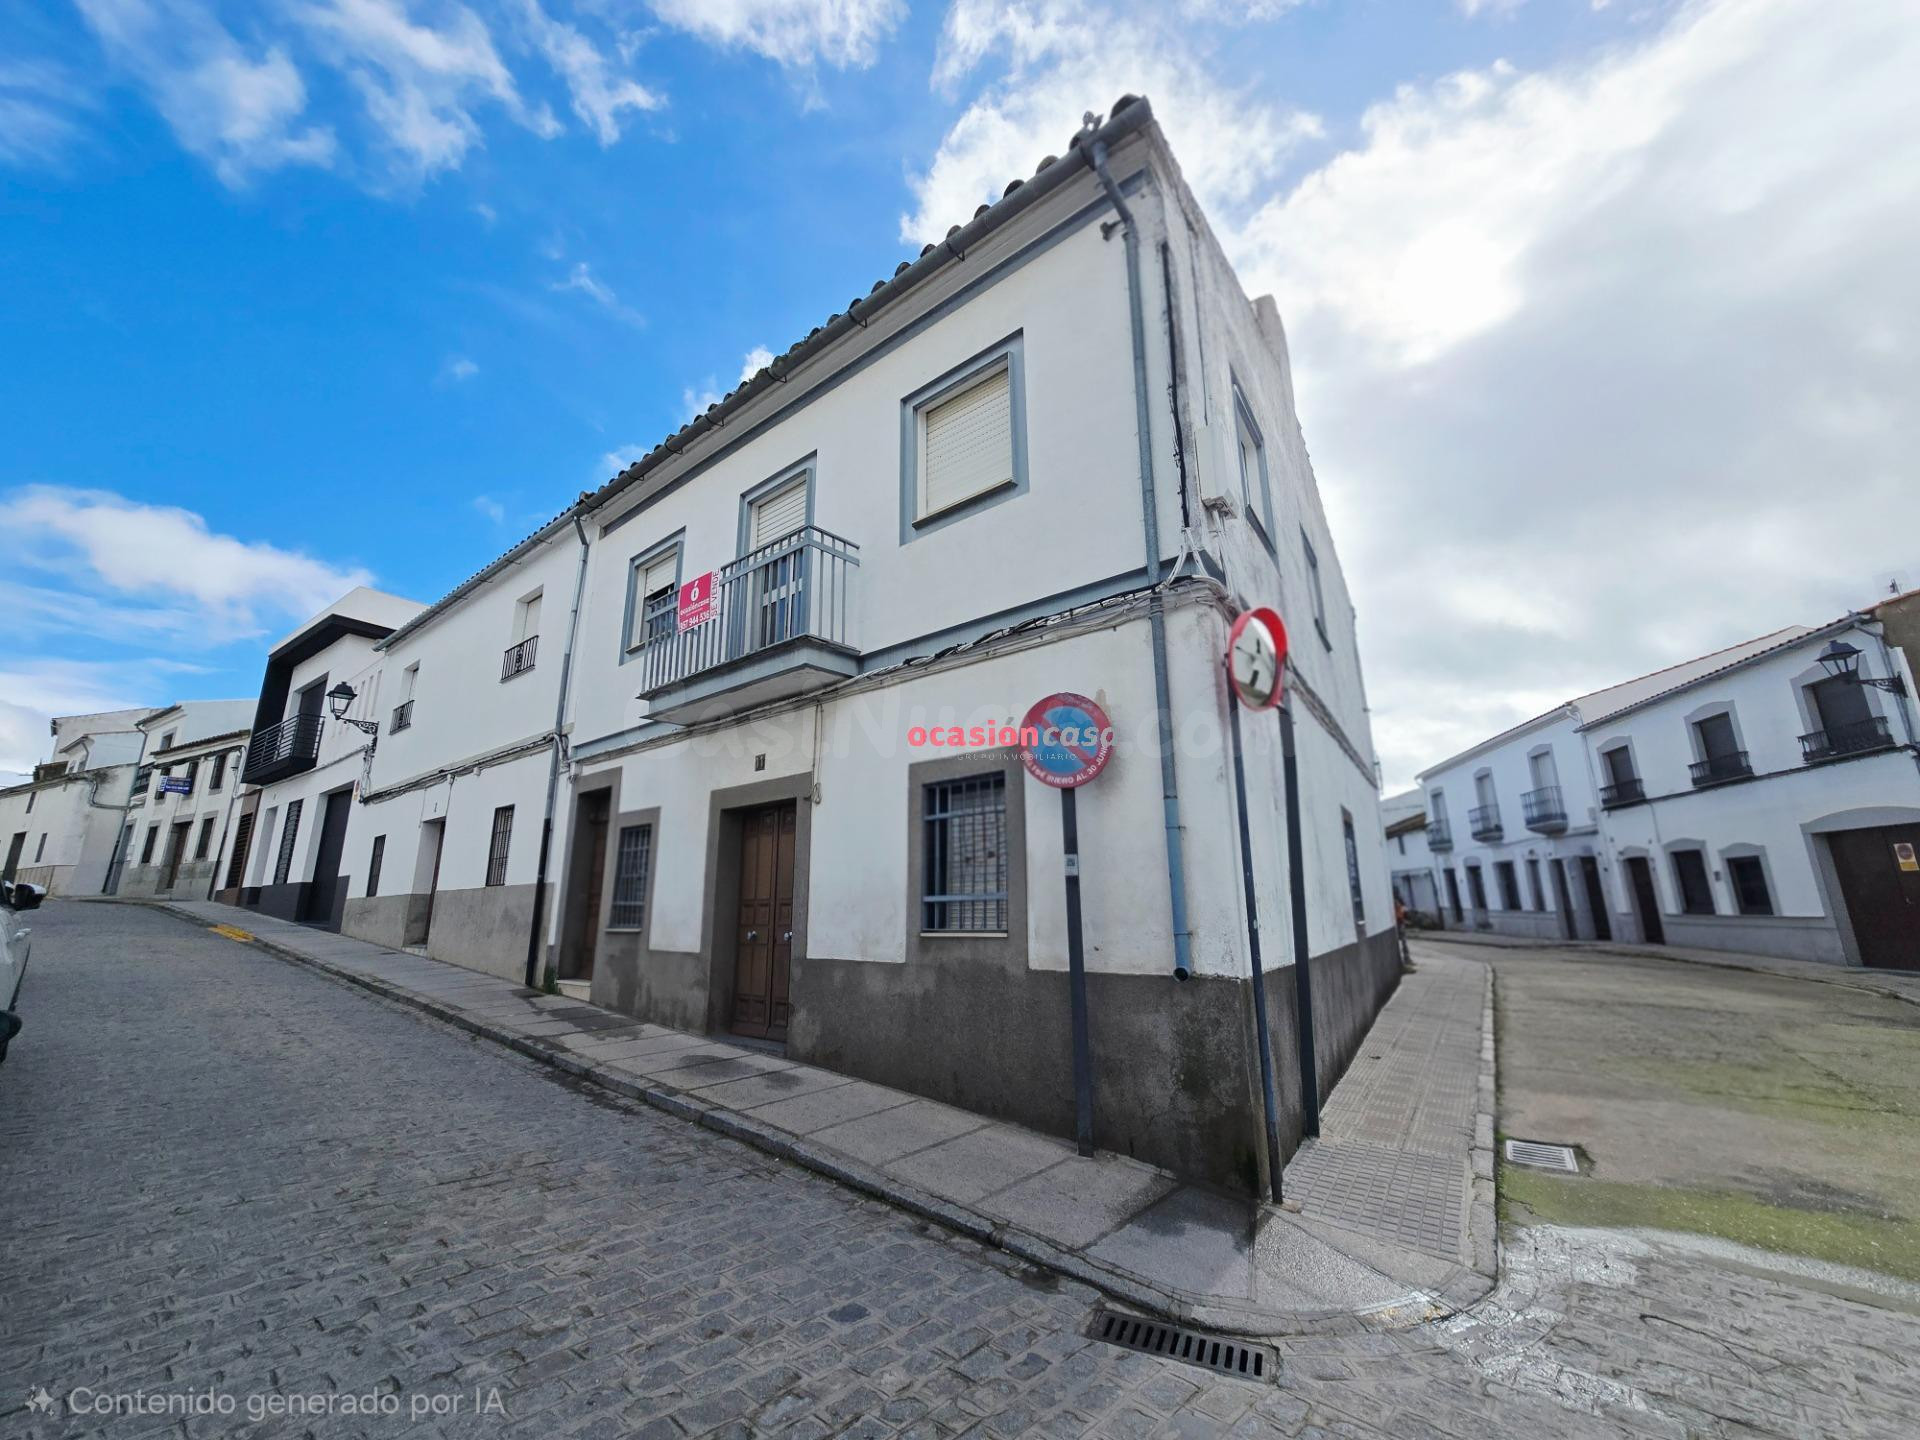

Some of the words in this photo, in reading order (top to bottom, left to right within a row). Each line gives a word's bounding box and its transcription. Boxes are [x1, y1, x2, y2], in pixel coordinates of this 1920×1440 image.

[1048, 776, 1074, 785] ENERO
[1077, 774, 1087, 782] AL
[1088, 766, 1097, 775] 30
[1097, 743, 1110, 765] JUNI
